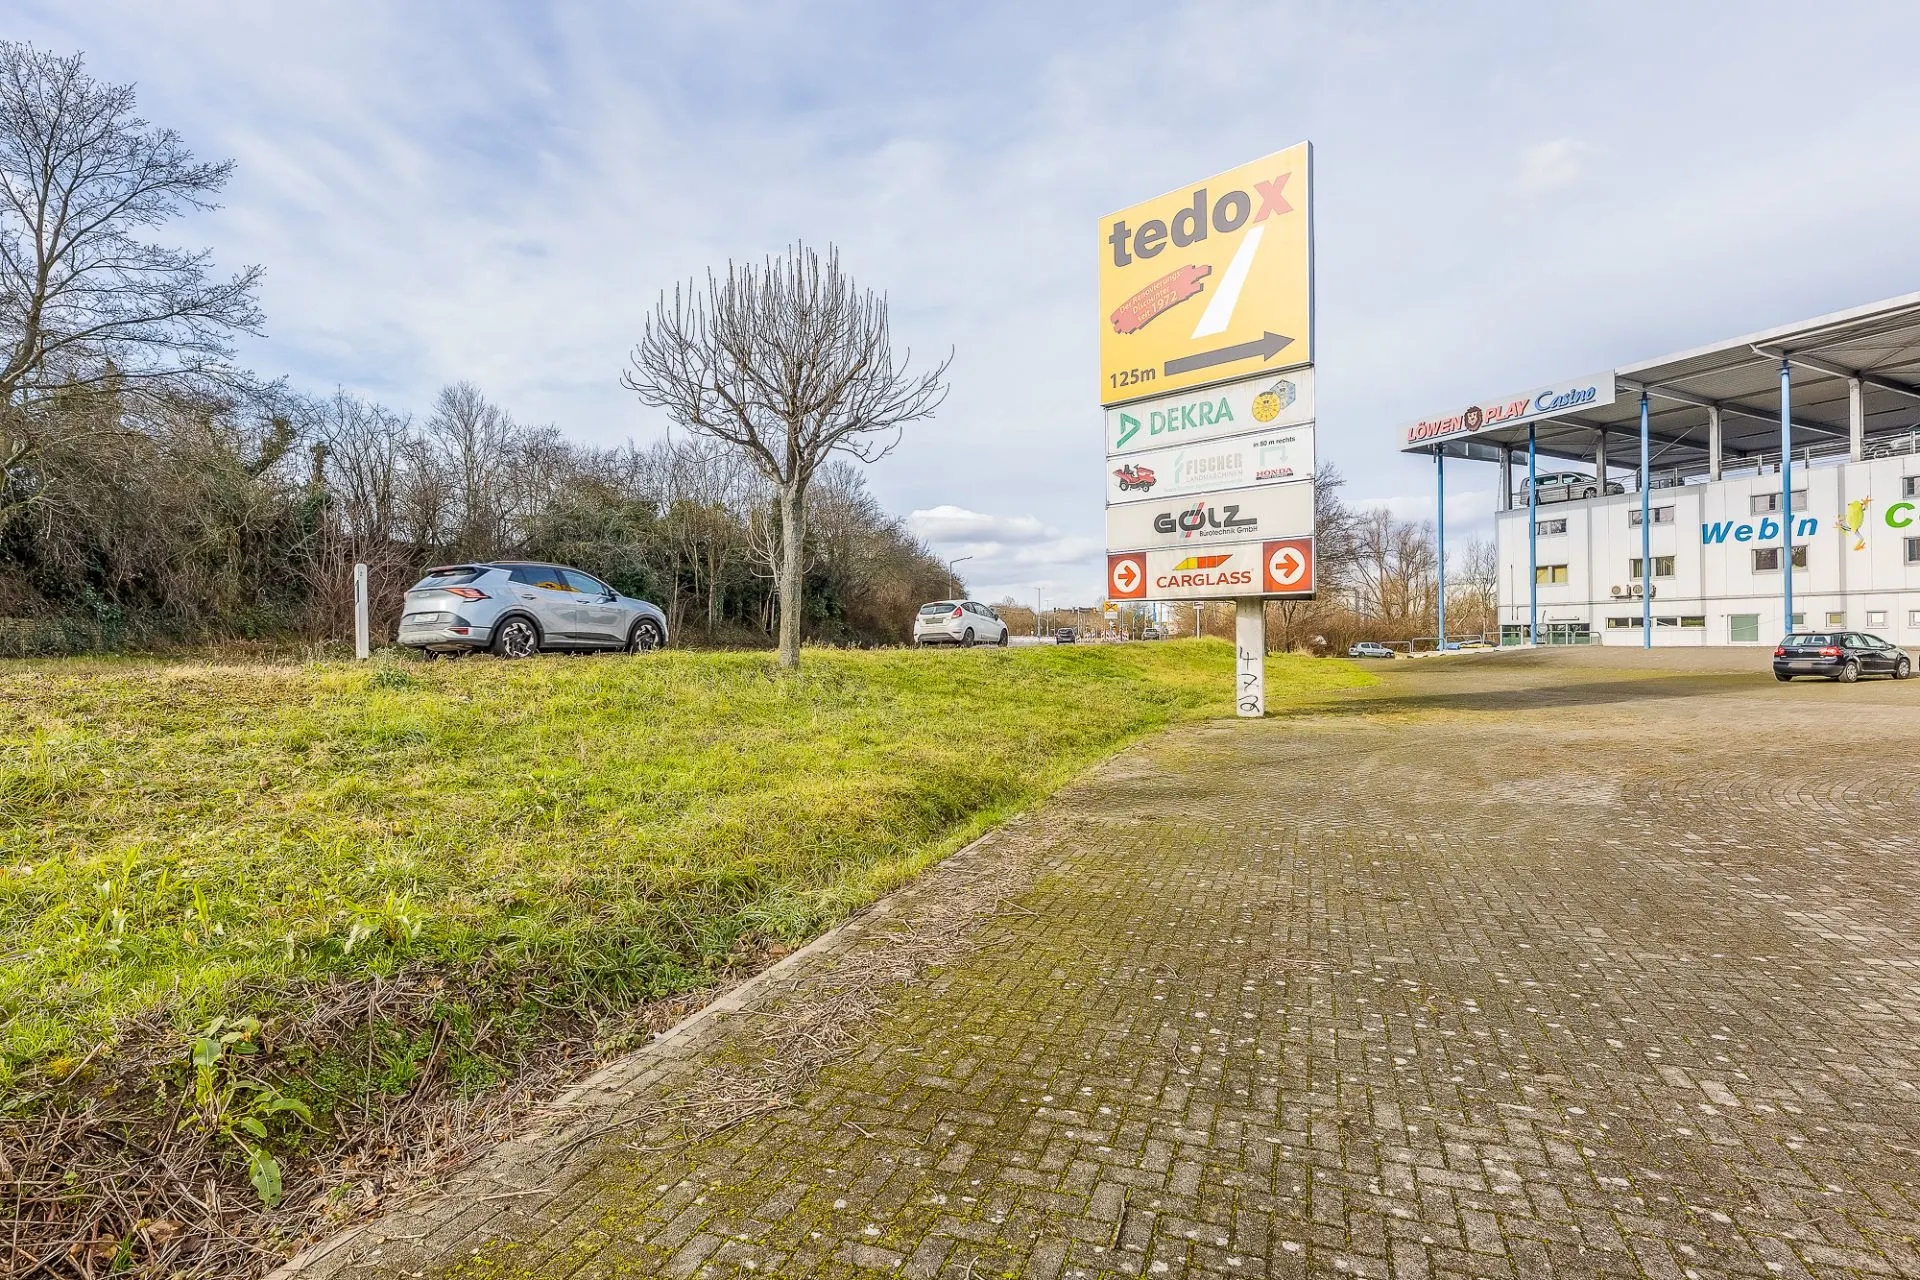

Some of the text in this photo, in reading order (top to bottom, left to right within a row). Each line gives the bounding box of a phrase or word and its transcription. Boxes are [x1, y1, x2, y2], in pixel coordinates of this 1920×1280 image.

[1109, 172, 1294, 267] tedox
[1119, 301, 1132, 314] Der
[1137, 290, 1177, 321] seit 1972
[1110, 366, 1156, 389] 125m
[1150, 397, 1235, 436] DEKRA
[1407, 386, 1597, 441] LÖWEN PLAY Casino
[1276, 436, 1296, 444] rechts
[1186, 453, 1243, 475] FISCHER
[1256, 467, 1293, 477] HONDA
[1885, 502, 1920, 529] C
[1199, 526, 1258, 537] Bürotechnik GmbH
[1156, 571, 1252, 588] CARGLASS
